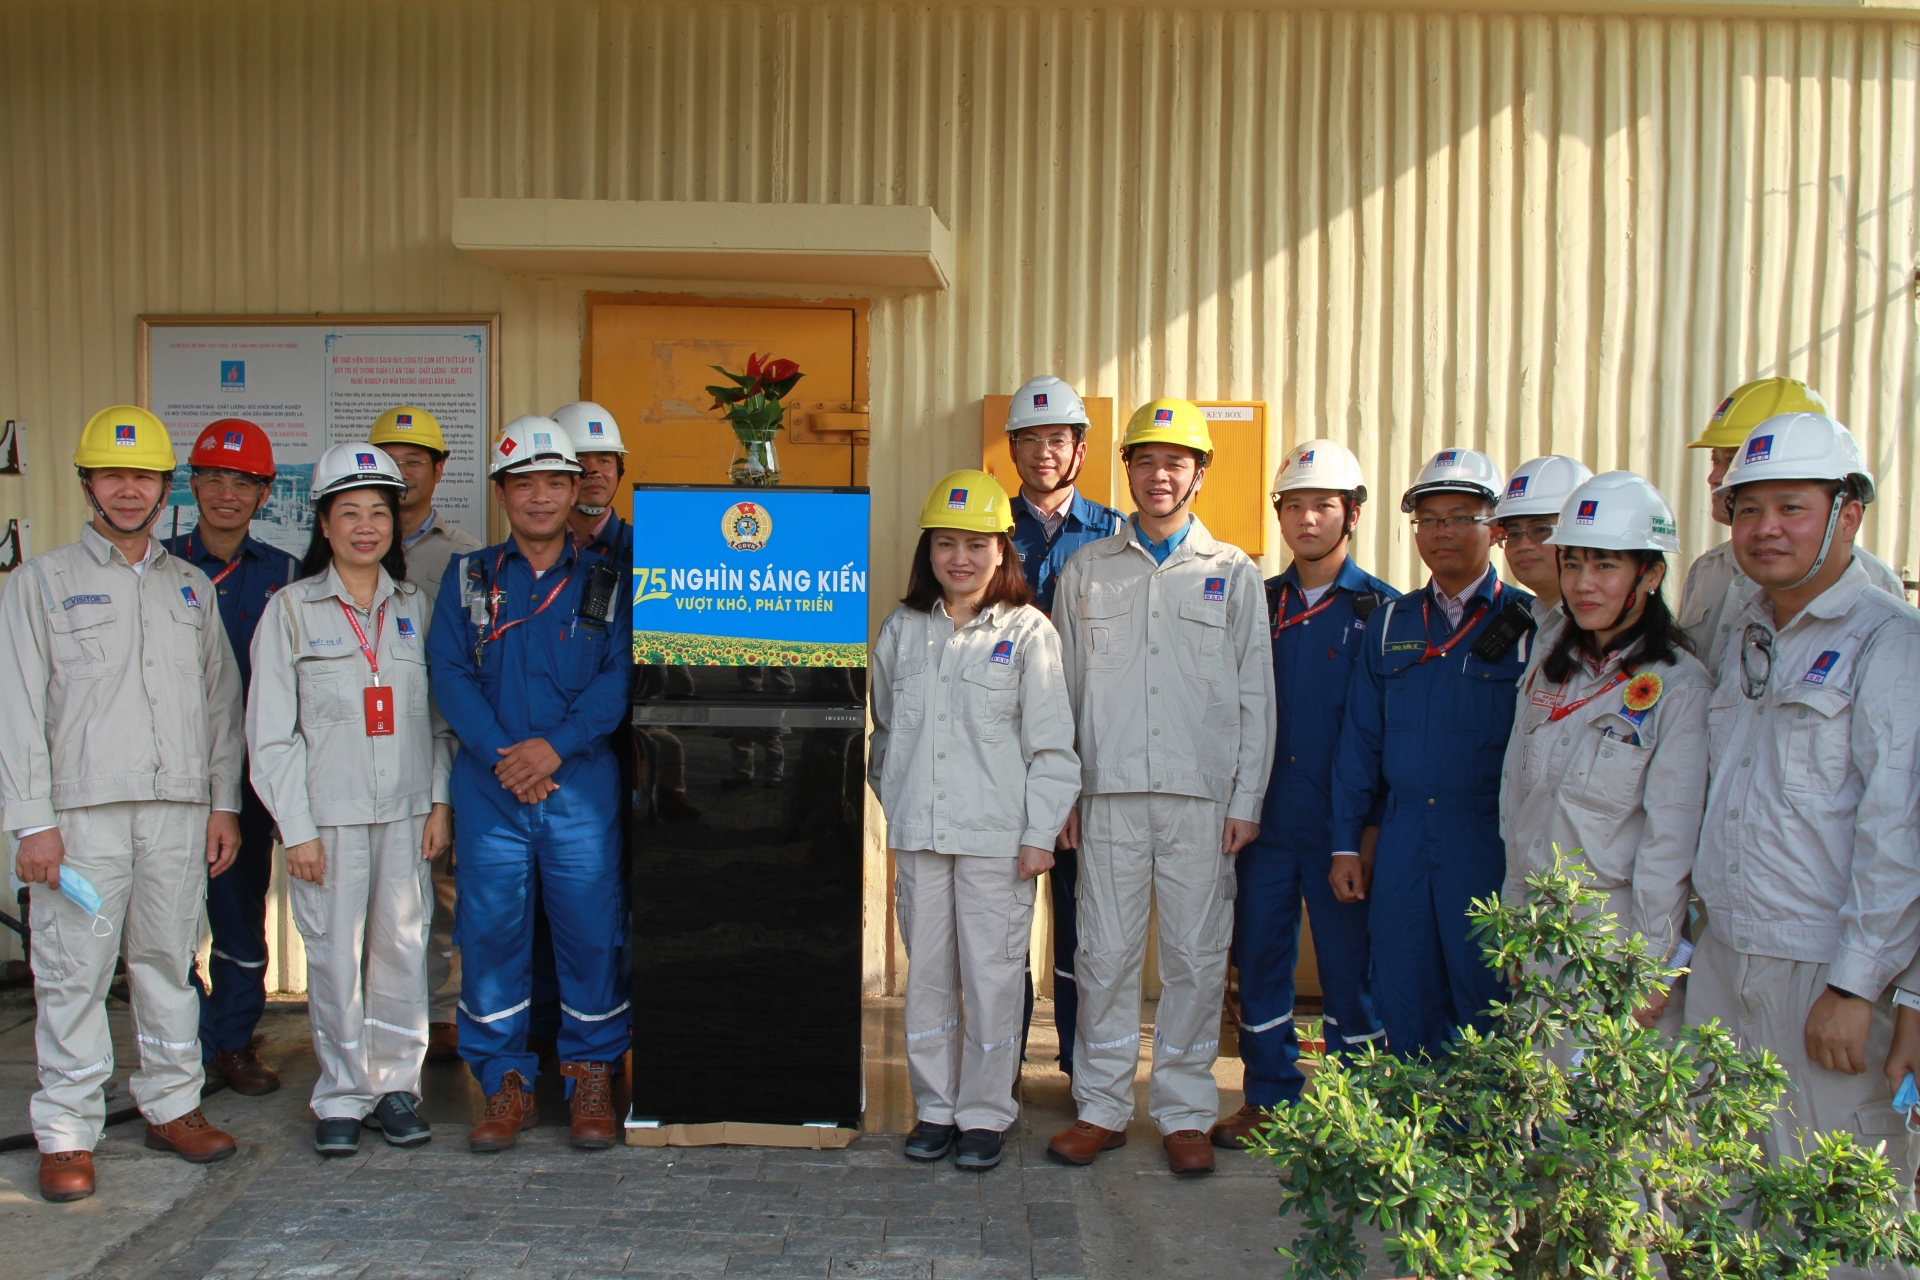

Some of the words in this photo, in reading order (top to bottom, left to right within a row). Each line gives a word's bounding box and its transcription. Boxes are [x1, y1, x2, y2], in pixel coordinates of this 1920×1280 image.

[632, 568, 667, 605] 75
[671, 562, 743, 591] NGHÌN
[750, 563, 811, 592] SÁNG
[818, 561, 866, 592] KIẾN
[675, 598, 713, 613] VƯỢT
[717, 595, 752, 613] KHÓ,
[756, 596, 791, 611] PHÁT
[796, 593, 833, 612] TRIỂN
